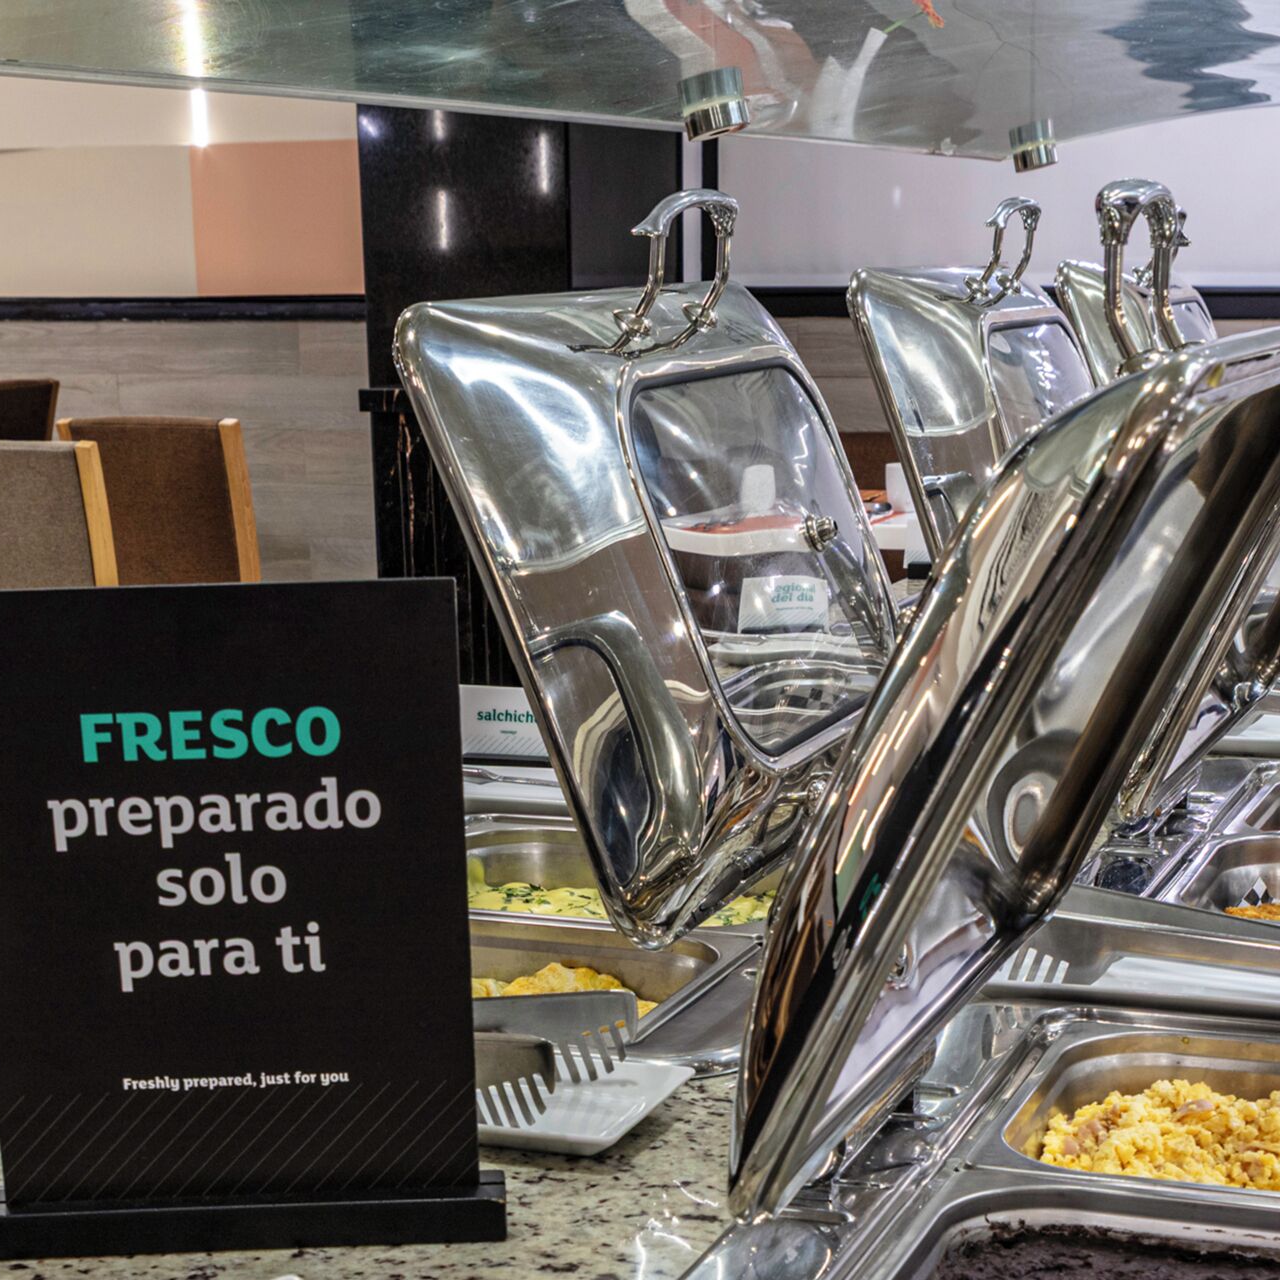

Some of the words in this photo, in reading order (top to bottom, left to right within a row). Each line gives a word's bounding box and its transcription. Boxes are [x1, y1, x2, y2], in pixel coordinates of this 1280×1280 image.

[79, 705, 342, 763] FRESCO
[476, 708, 538, 724] salchich
[46, 776, 382, 852] preparado
[155, 852, 288, 907] solo
[113, 936, 261, 992] para
[275, 921, 327, 974] ti
[123, 1075, 180, 1092] Freshly
[182, 1072, 258, 1091] prepared,
[259, 1072, 291, 1088] just
[293, 1071, 317, 1084] for
[319, 1072, 350, 1087] you
